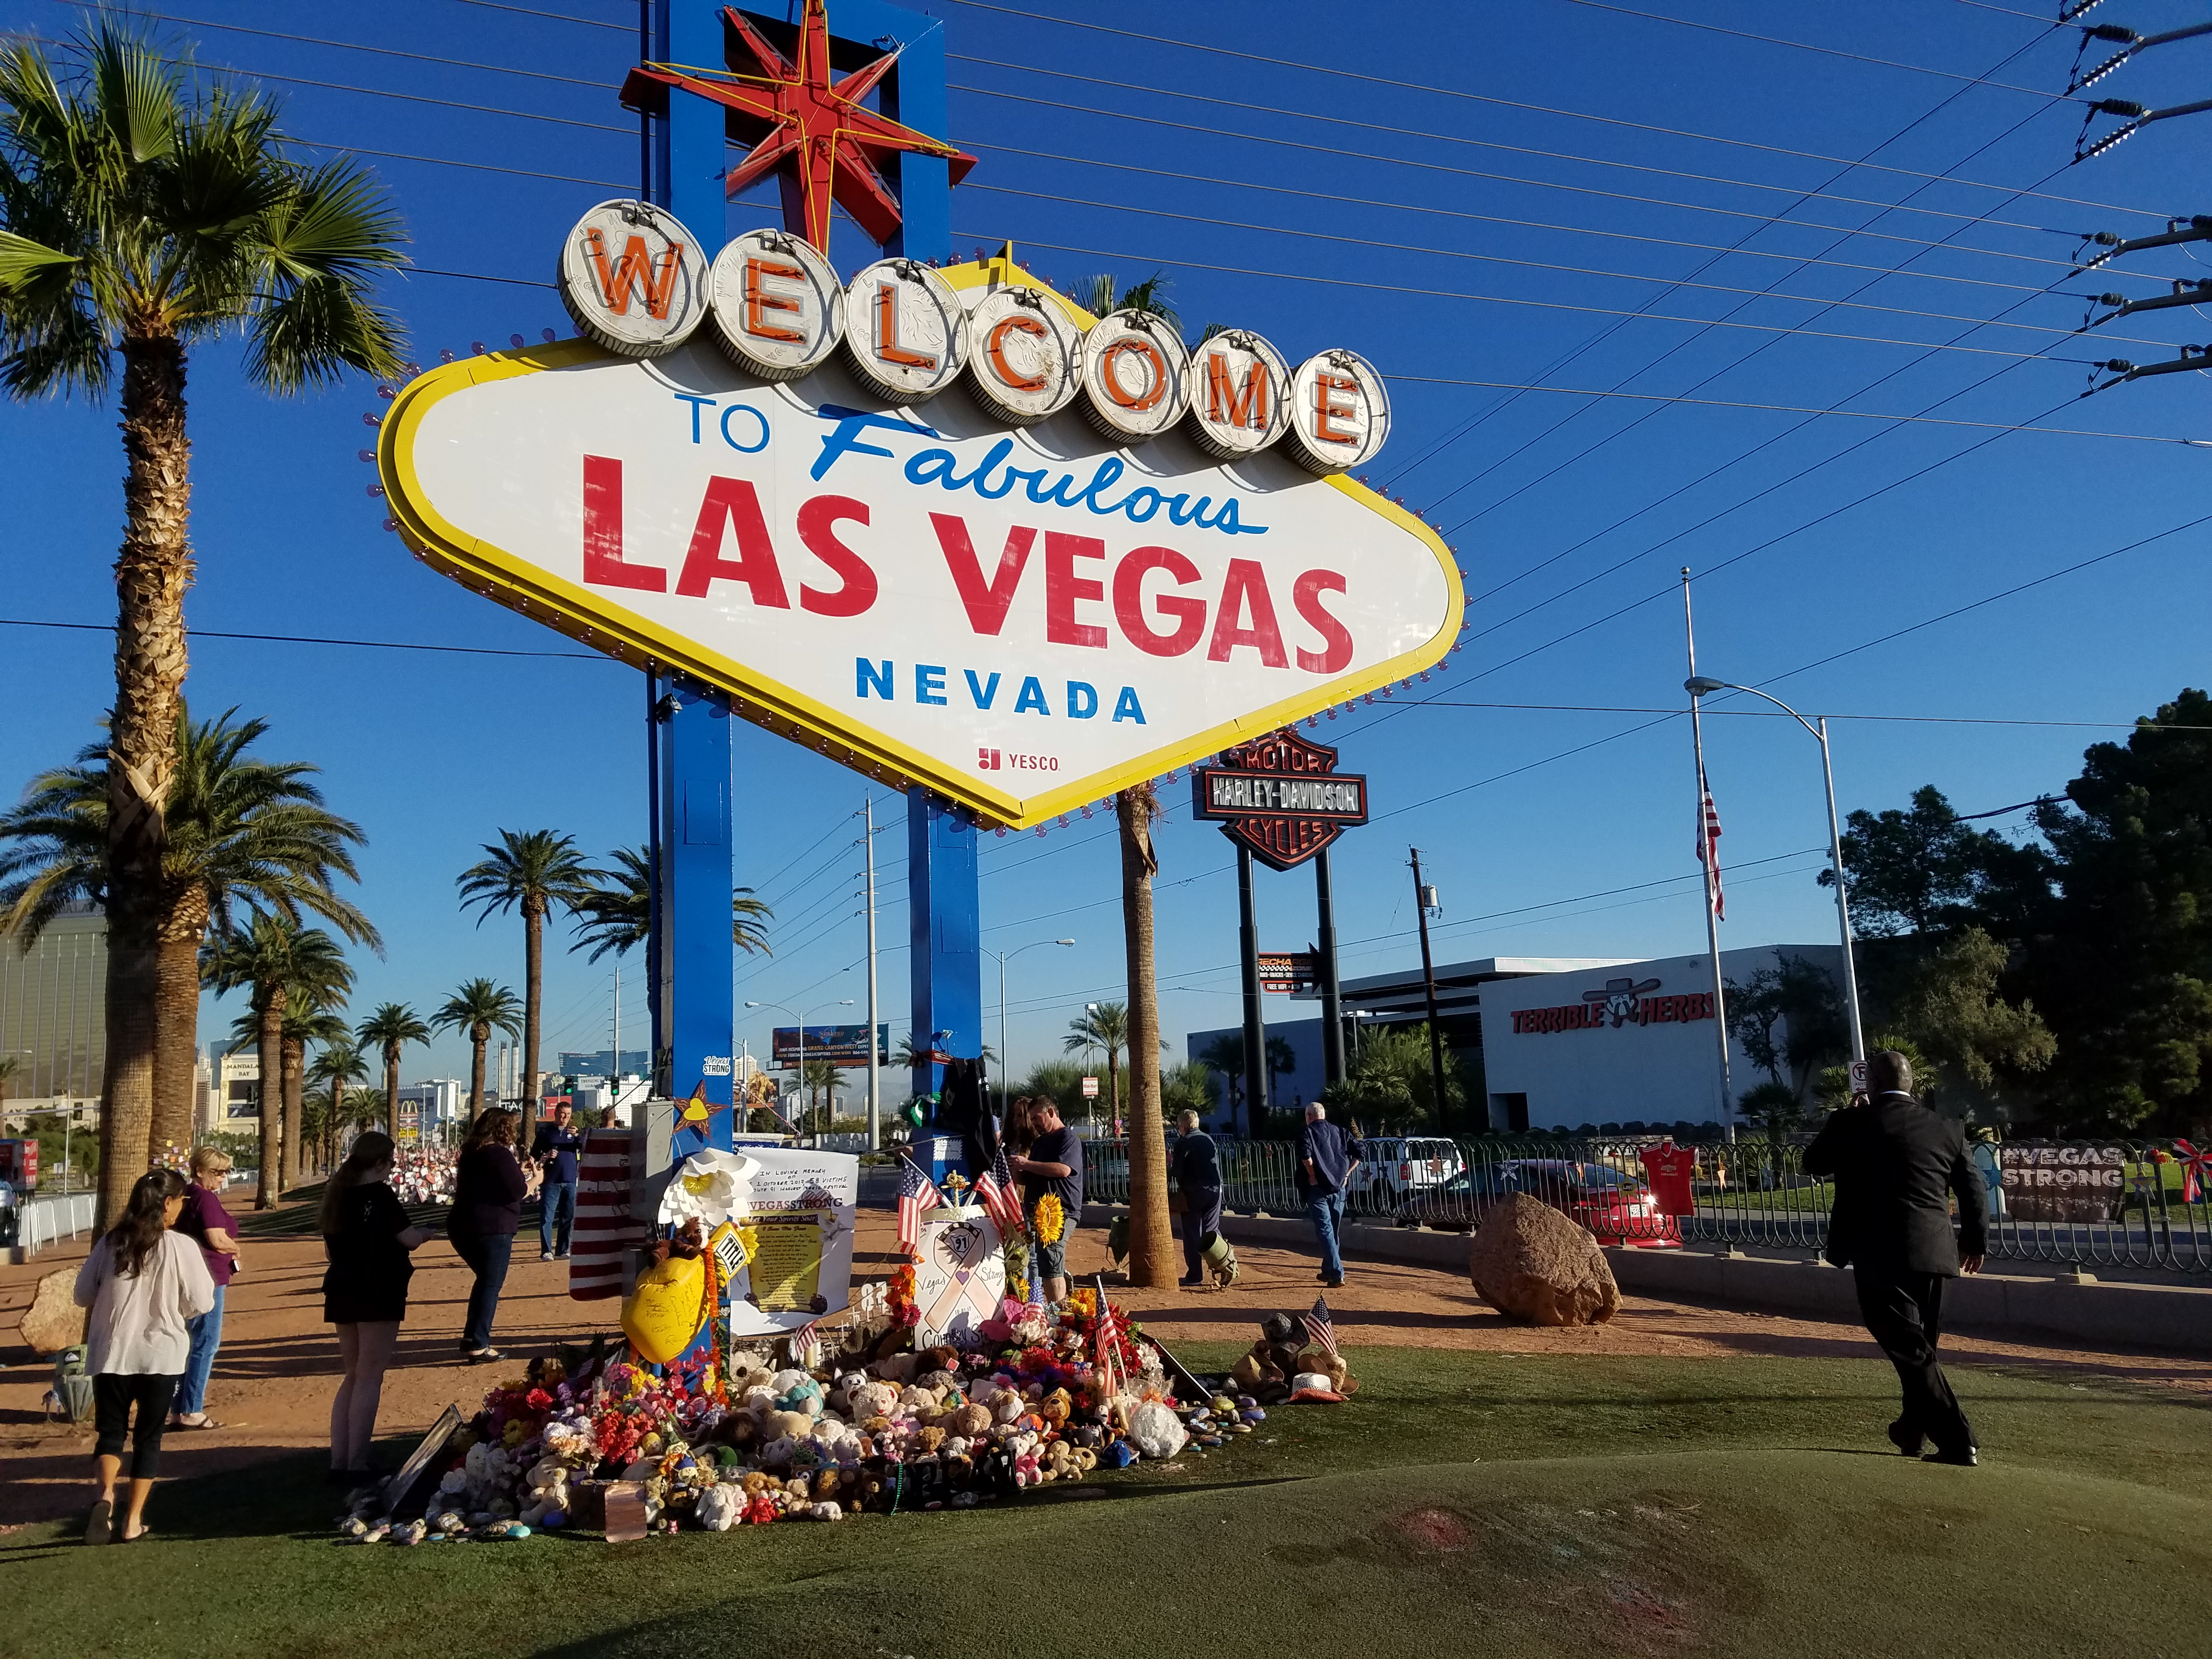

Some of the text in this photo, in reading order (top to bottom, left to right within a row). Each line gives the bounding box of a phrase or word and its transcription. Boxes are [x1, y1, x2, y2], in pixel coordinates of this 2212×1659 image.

[587, 228, 1362, 448] WELCOME
[674, 393, 1269, 535] TO Fabulous
[583, 453, 1353, 674] LAS VEGAS
[856, 657, 1148, 725] NEVADA
[1009, 753, 1059, 771] YESCO
[1246, 740, 1322, 772] MOTOR
[1213, 777, 1359, 811] HARLEY-DAVIDSON
[1249, 819, 1325, 855] CYCLES
[1511, 991, 1716, 1034] TERRIBLE HERBS
[704, 1064, 729, 1073] STRONG
[705, 1056, 730, 1065] Vegas
[2002, 1148, 2122, 1165] #VEGAS
[2002, 1169, 2123, 1187] STRONG
[747, 1197, 843, 1210] VEGASSTRONG
[778, 1215, 799, 1223] Spirits
[956, 1237, 967, 1250] 91
[915, 1276, 946, 1295] Vegas
[981, 1267, 1004, 1286] Strong
